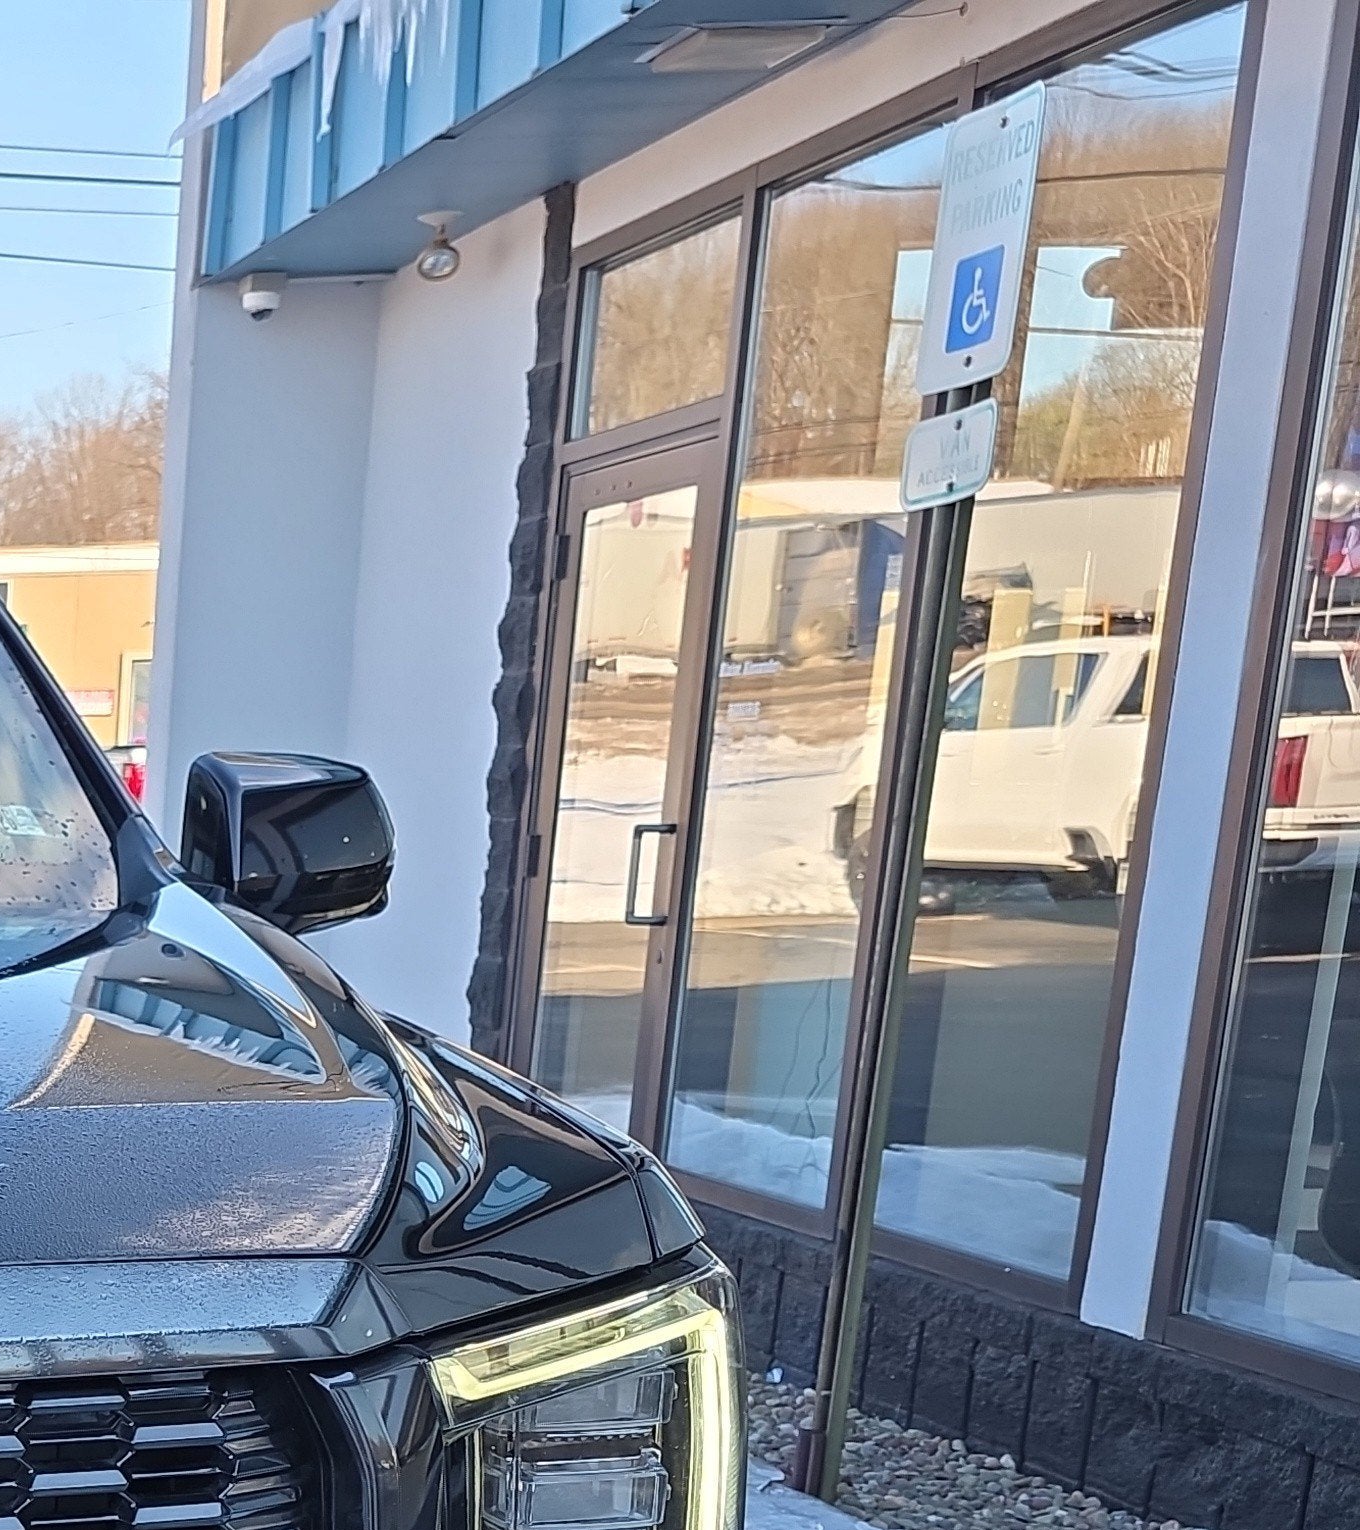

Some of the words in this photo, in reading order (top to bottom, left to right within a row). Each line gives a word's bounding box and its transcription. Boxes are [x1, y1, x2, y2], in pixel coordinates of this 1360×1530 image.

[951, 120, 1036, 187] RESERVED
[950, 177, 1023, 238] PARKING
[940, 428, 972, 459] VAN
